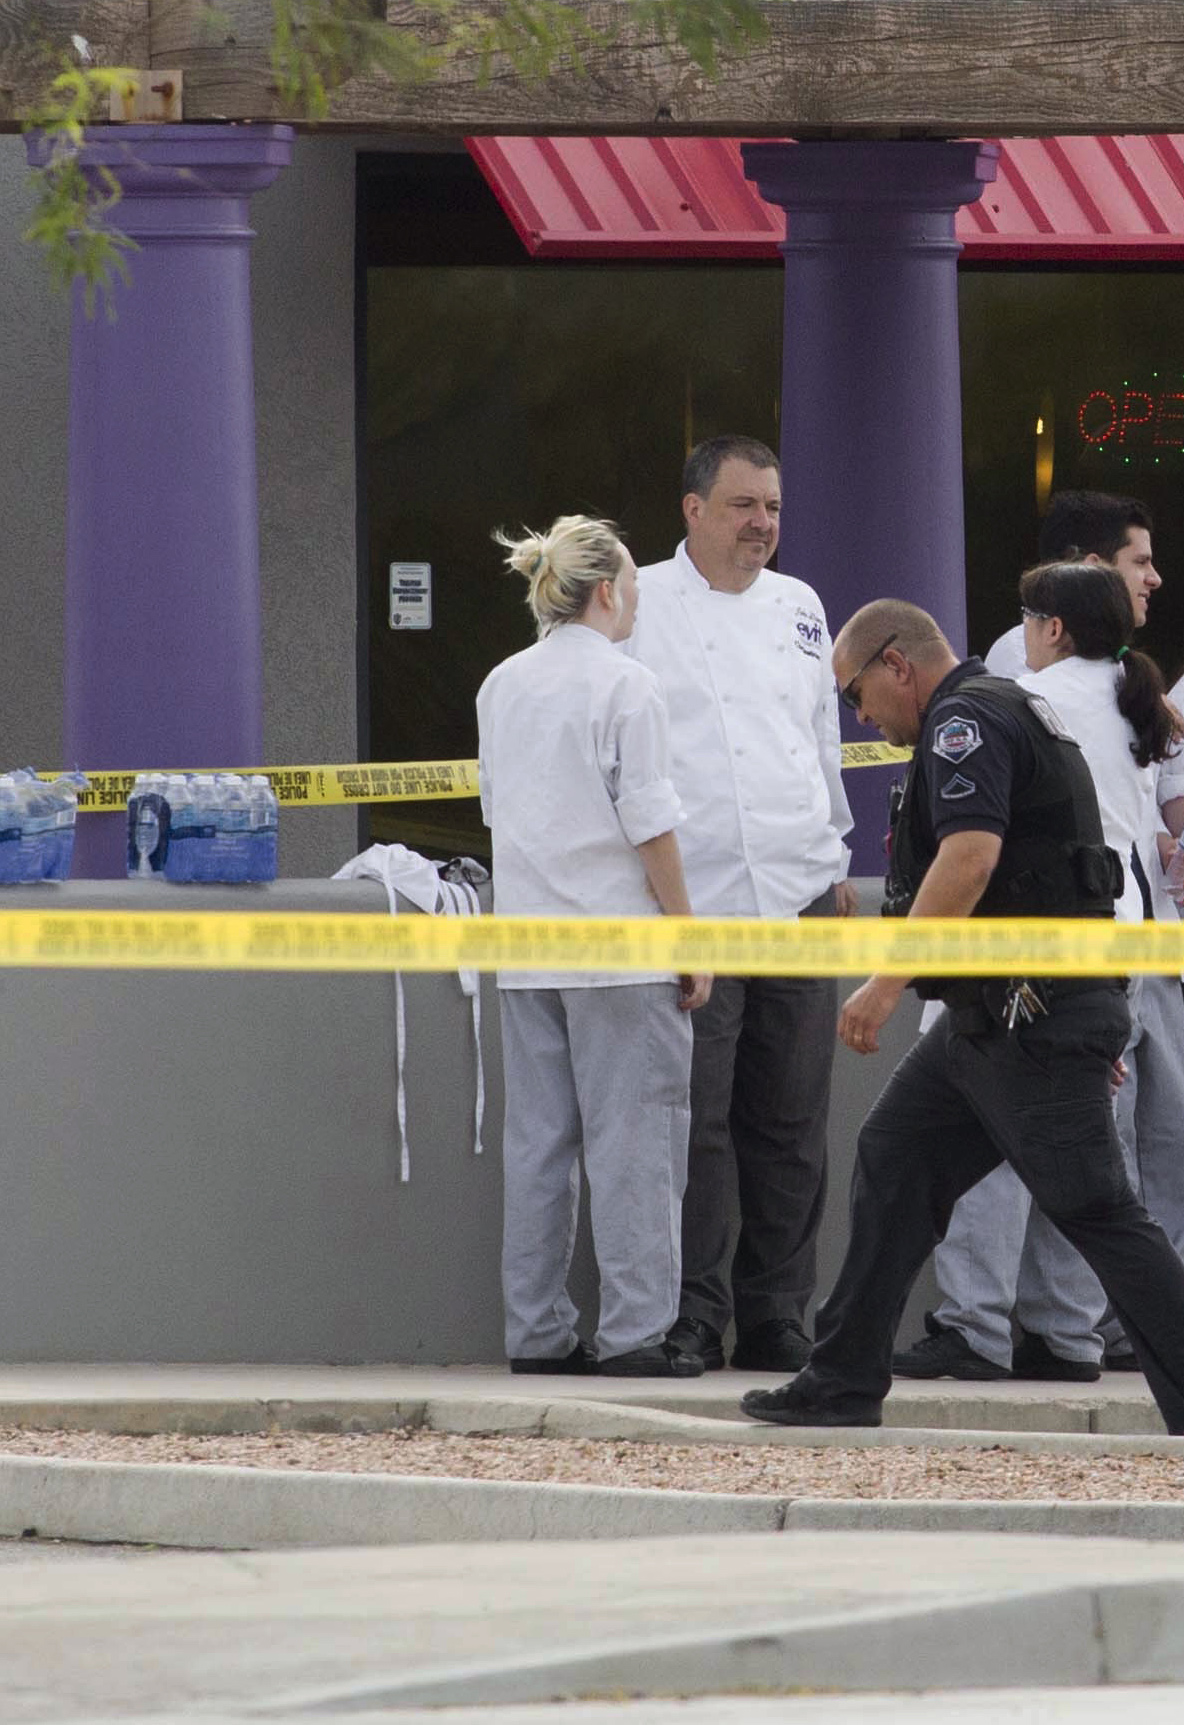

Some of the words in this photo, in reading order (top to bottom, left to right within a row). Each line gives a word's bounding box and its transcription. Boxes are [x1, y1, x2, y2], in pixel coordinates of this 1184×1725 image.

[797, 622, 822, 645] evit
[77, 792, 95, 805] LIN
[99, 791, 131, 805] OLICE
[279, 786, 308, 800] POLICE
